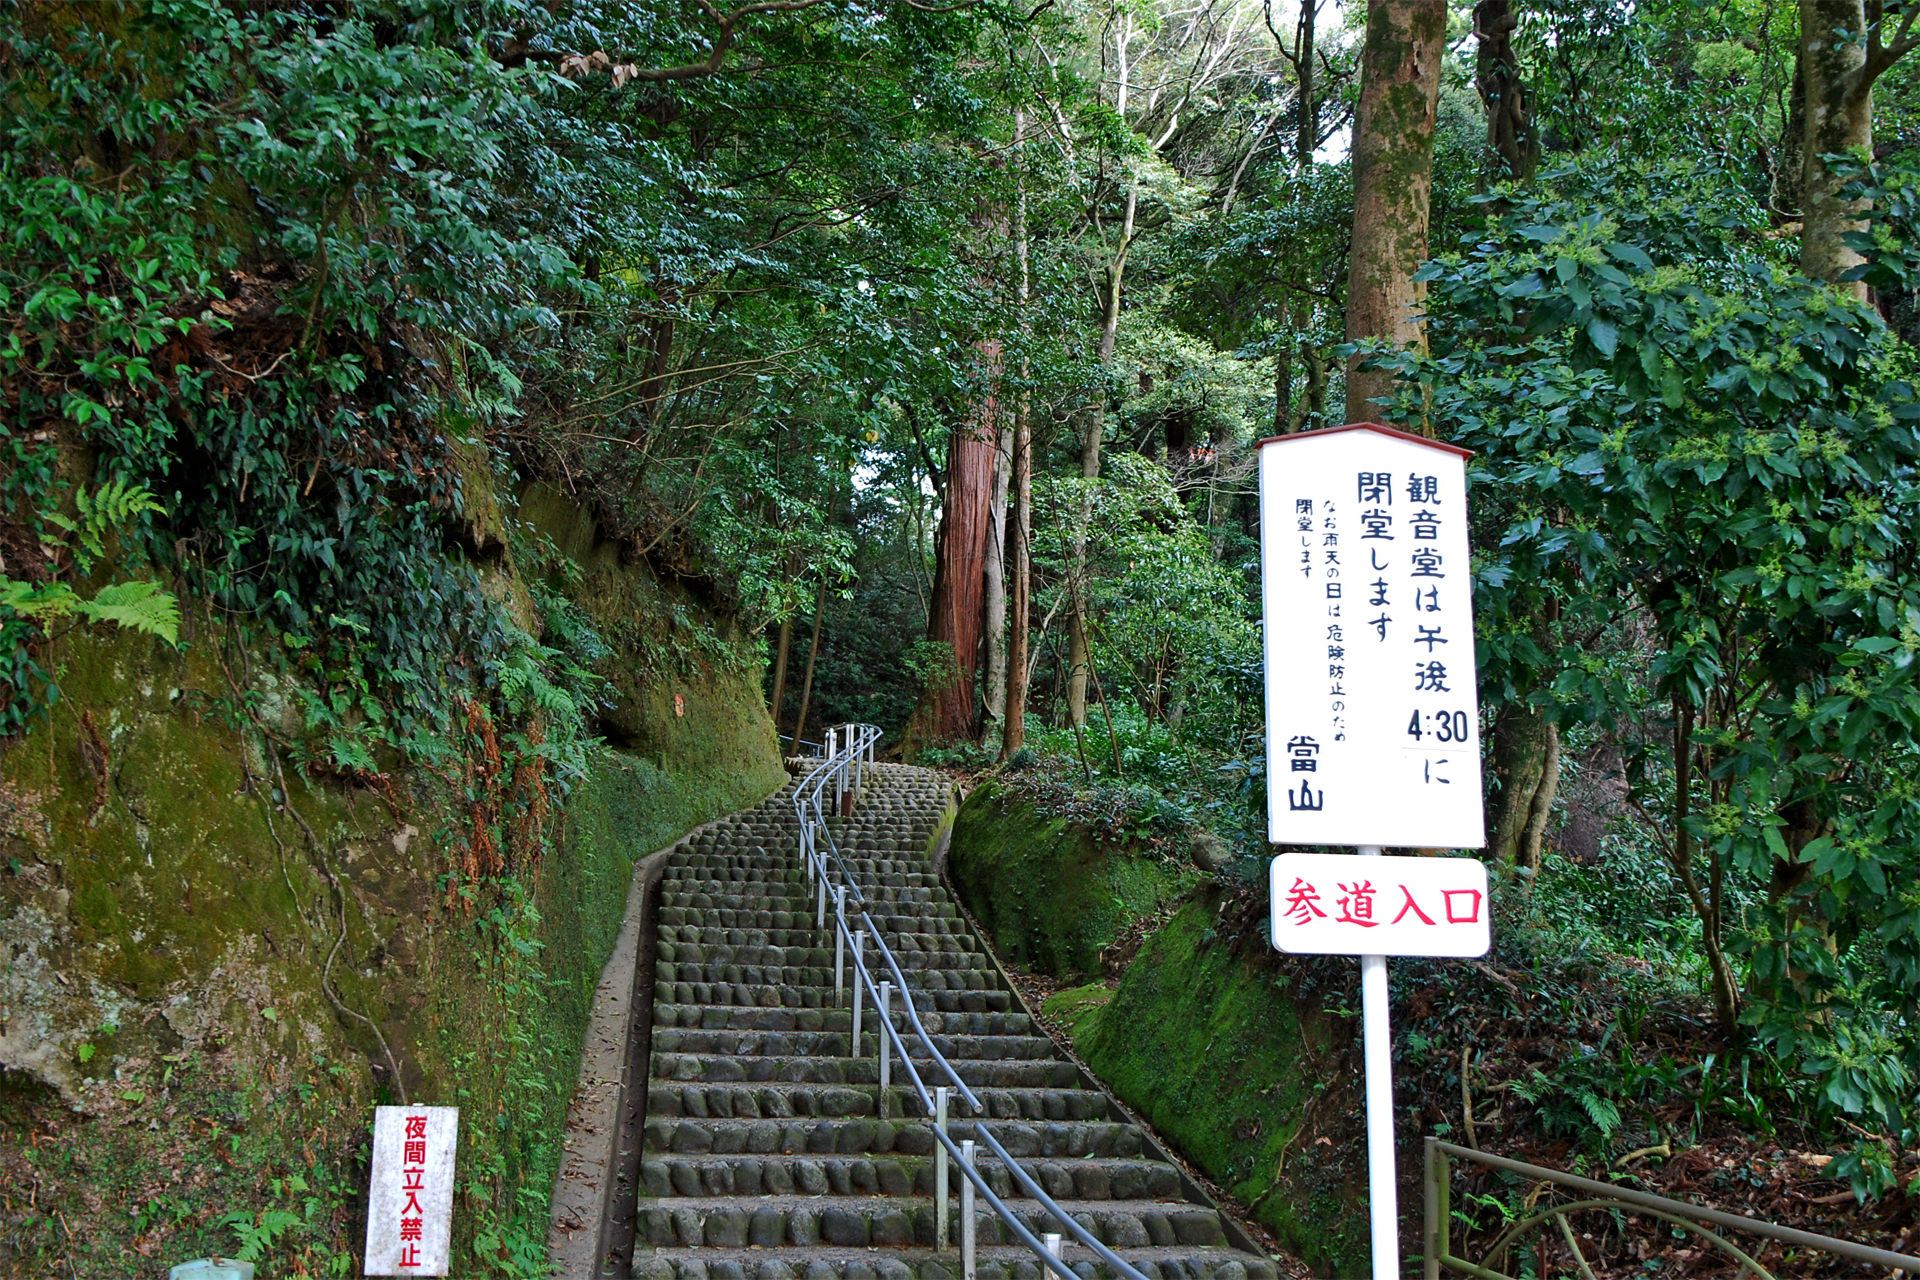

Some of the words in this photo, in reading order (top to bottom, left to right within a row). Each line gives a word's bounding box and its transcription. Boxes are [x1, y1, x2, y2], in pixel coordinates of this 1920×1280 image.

[1295, 498, 1314, 579] 閉堂します
[1357, 471, 1395, 643] 閉堂します
[1322, 500, 1346, 742] なお雨天の日は危険防止のため
[1286, 735, 1324, 812] 當山
[1282, 877, 1483, 928] 参道入口
[398, 1115, 428, 1268] 夜間立入禁止
